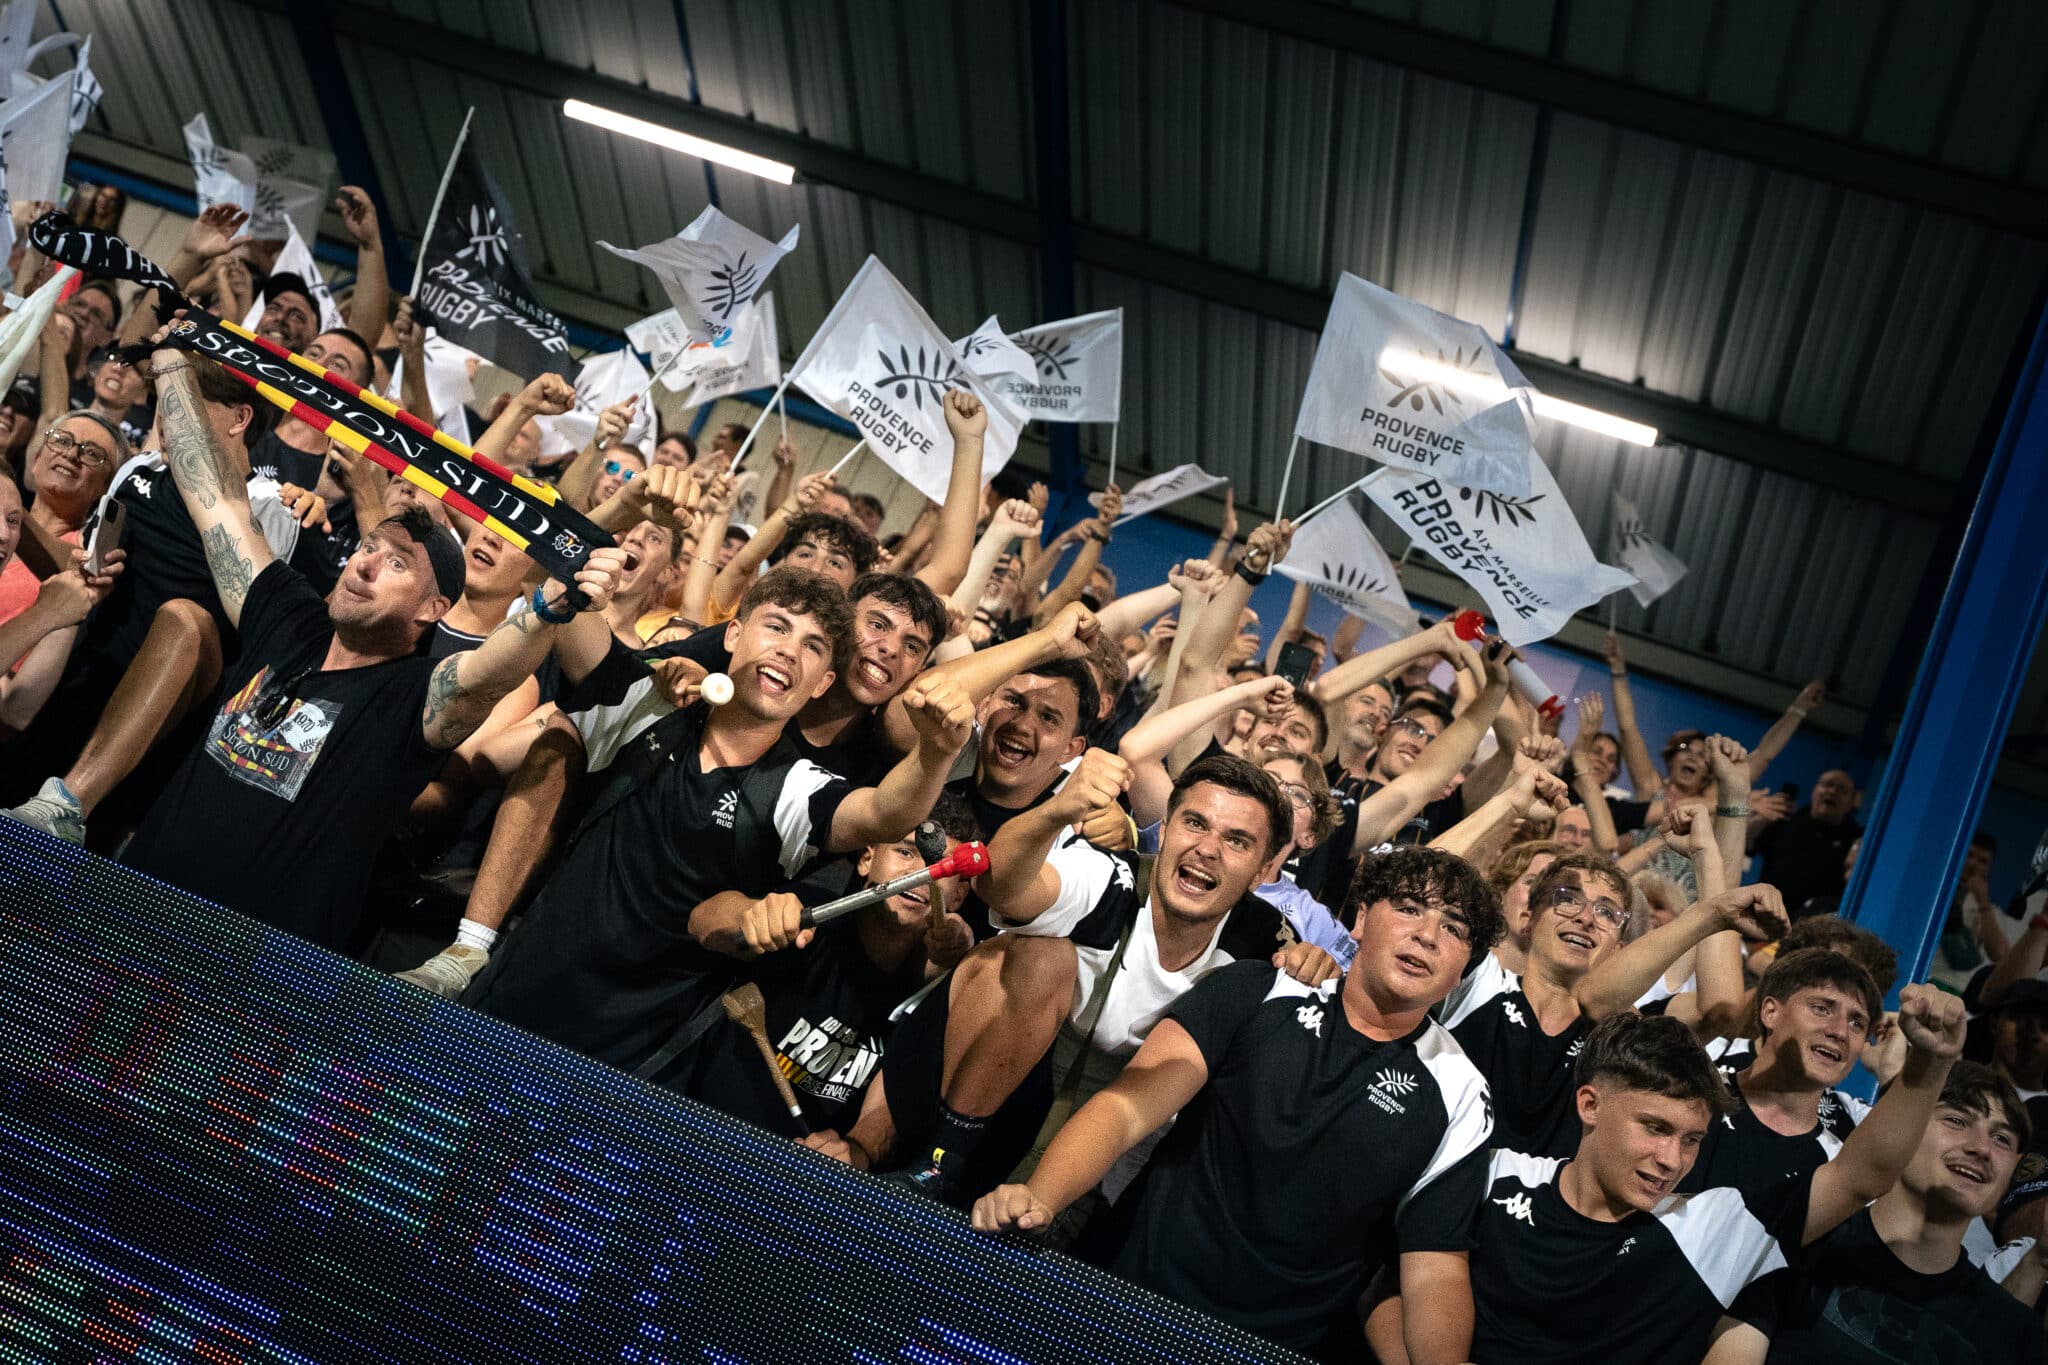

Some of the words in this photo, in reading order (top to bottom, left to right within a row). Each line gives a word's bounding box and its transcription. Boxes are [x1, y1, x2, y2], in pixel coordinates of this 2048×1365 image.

[192, 332, 429, 460] SECTION
[434, 460, 550, 536] SUD
[848, 381, 934, 455] PROVENCE
[850, 405, 908, 454] RUGBY
[1360, 407, 1465, 456] PROVENCE
[1372, 432, 1441, 466] RUGBY
[1393, 489, 1483, 572] RUGBY
[1472, 528, 1493, 552] AIX
[1415, 479, 1538, 620] PROVENCE
[262, 751, 290, 771] SUD
[711, 810, 735, 822] PROV
[715, 818, 733, 829] RUG
[821, 1083, 852, 1101] FINALE
[1366, 1084, 1407, 1114] PROVENCE
[1368, 1094, 1396, 1114] RUGBY
